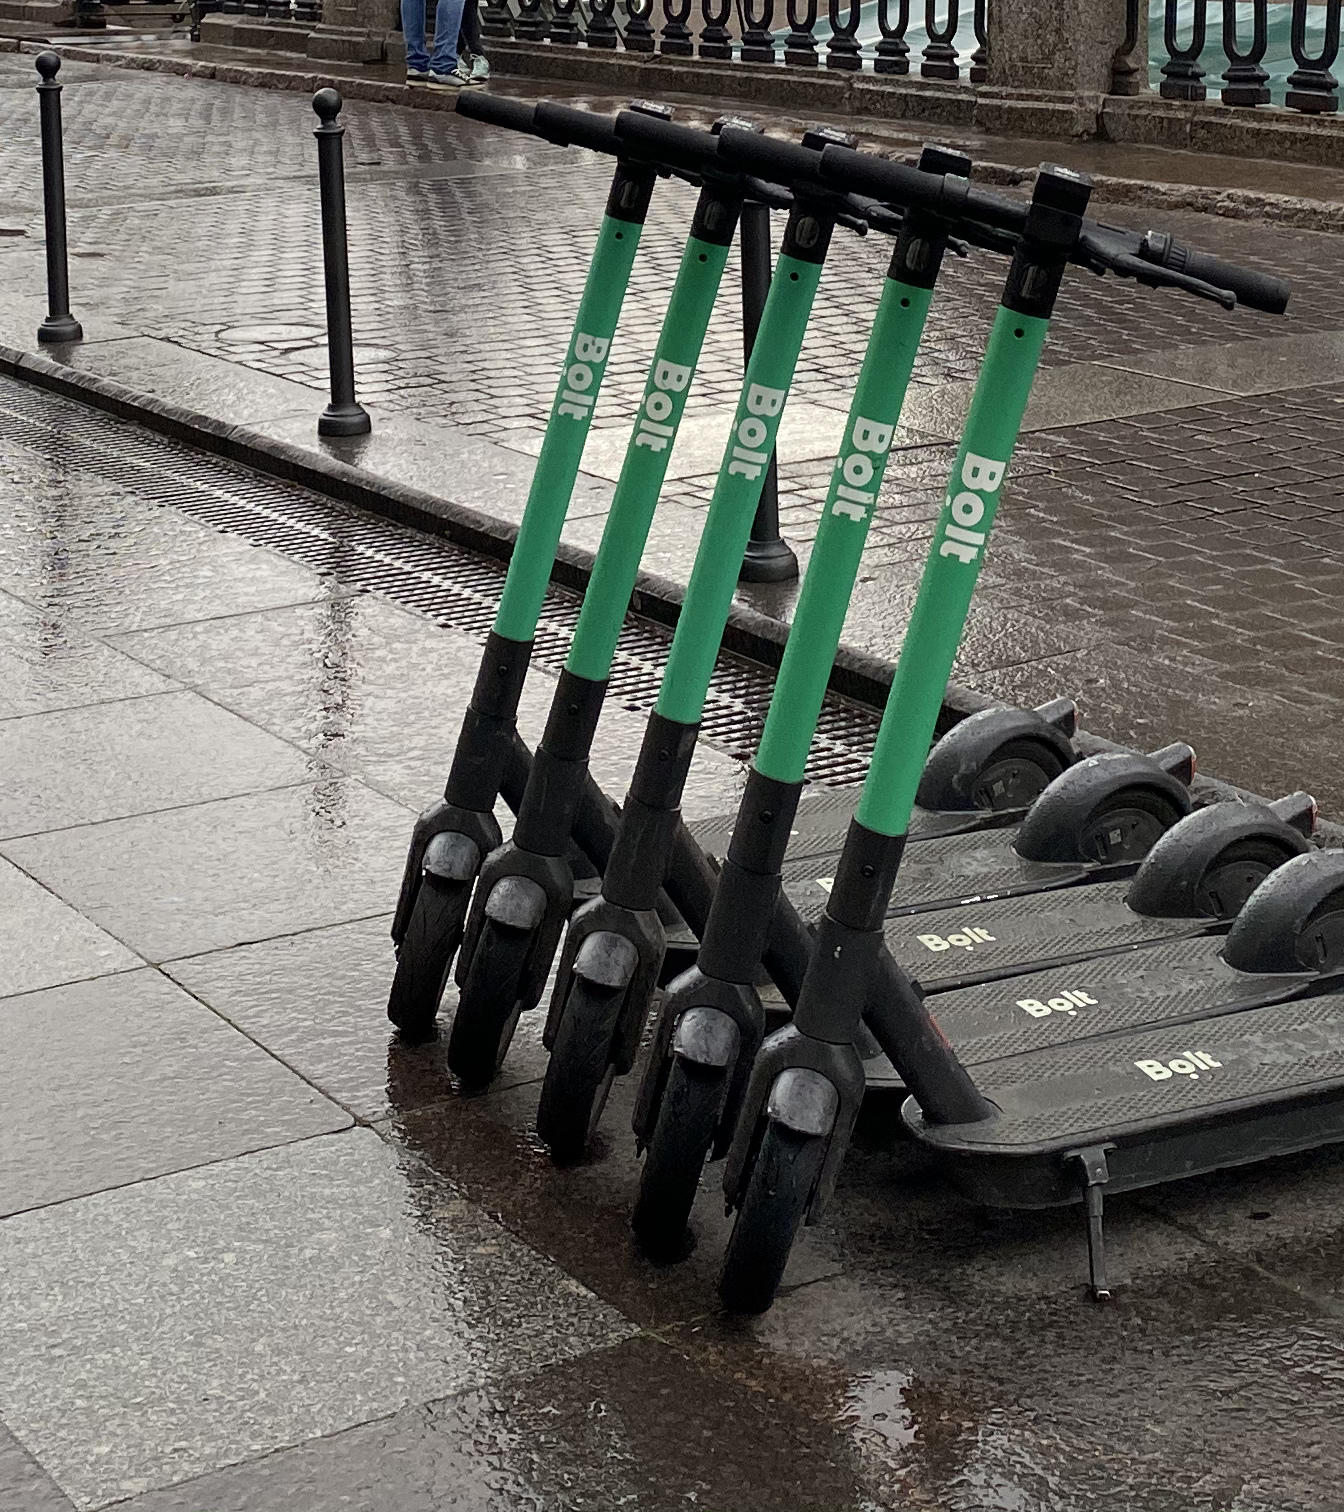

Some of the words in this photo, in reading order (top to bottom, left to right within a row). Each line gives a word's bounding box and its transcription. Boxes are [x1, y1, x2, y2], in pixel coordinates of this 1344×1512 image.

[558, 332, 610, 421] Bolt
[635, 358, 692, 452] Bolt
[728, 383, 786, 481] Bolt
[831, 416, 895, 522] Bolt
[940, 451, 1006, 565] Bolt
[916, 926, 997, 952] Bolt
[1015, 989, 1100, 1018] Bolt
[1133, 1050, 1223, 1081] Bolt
